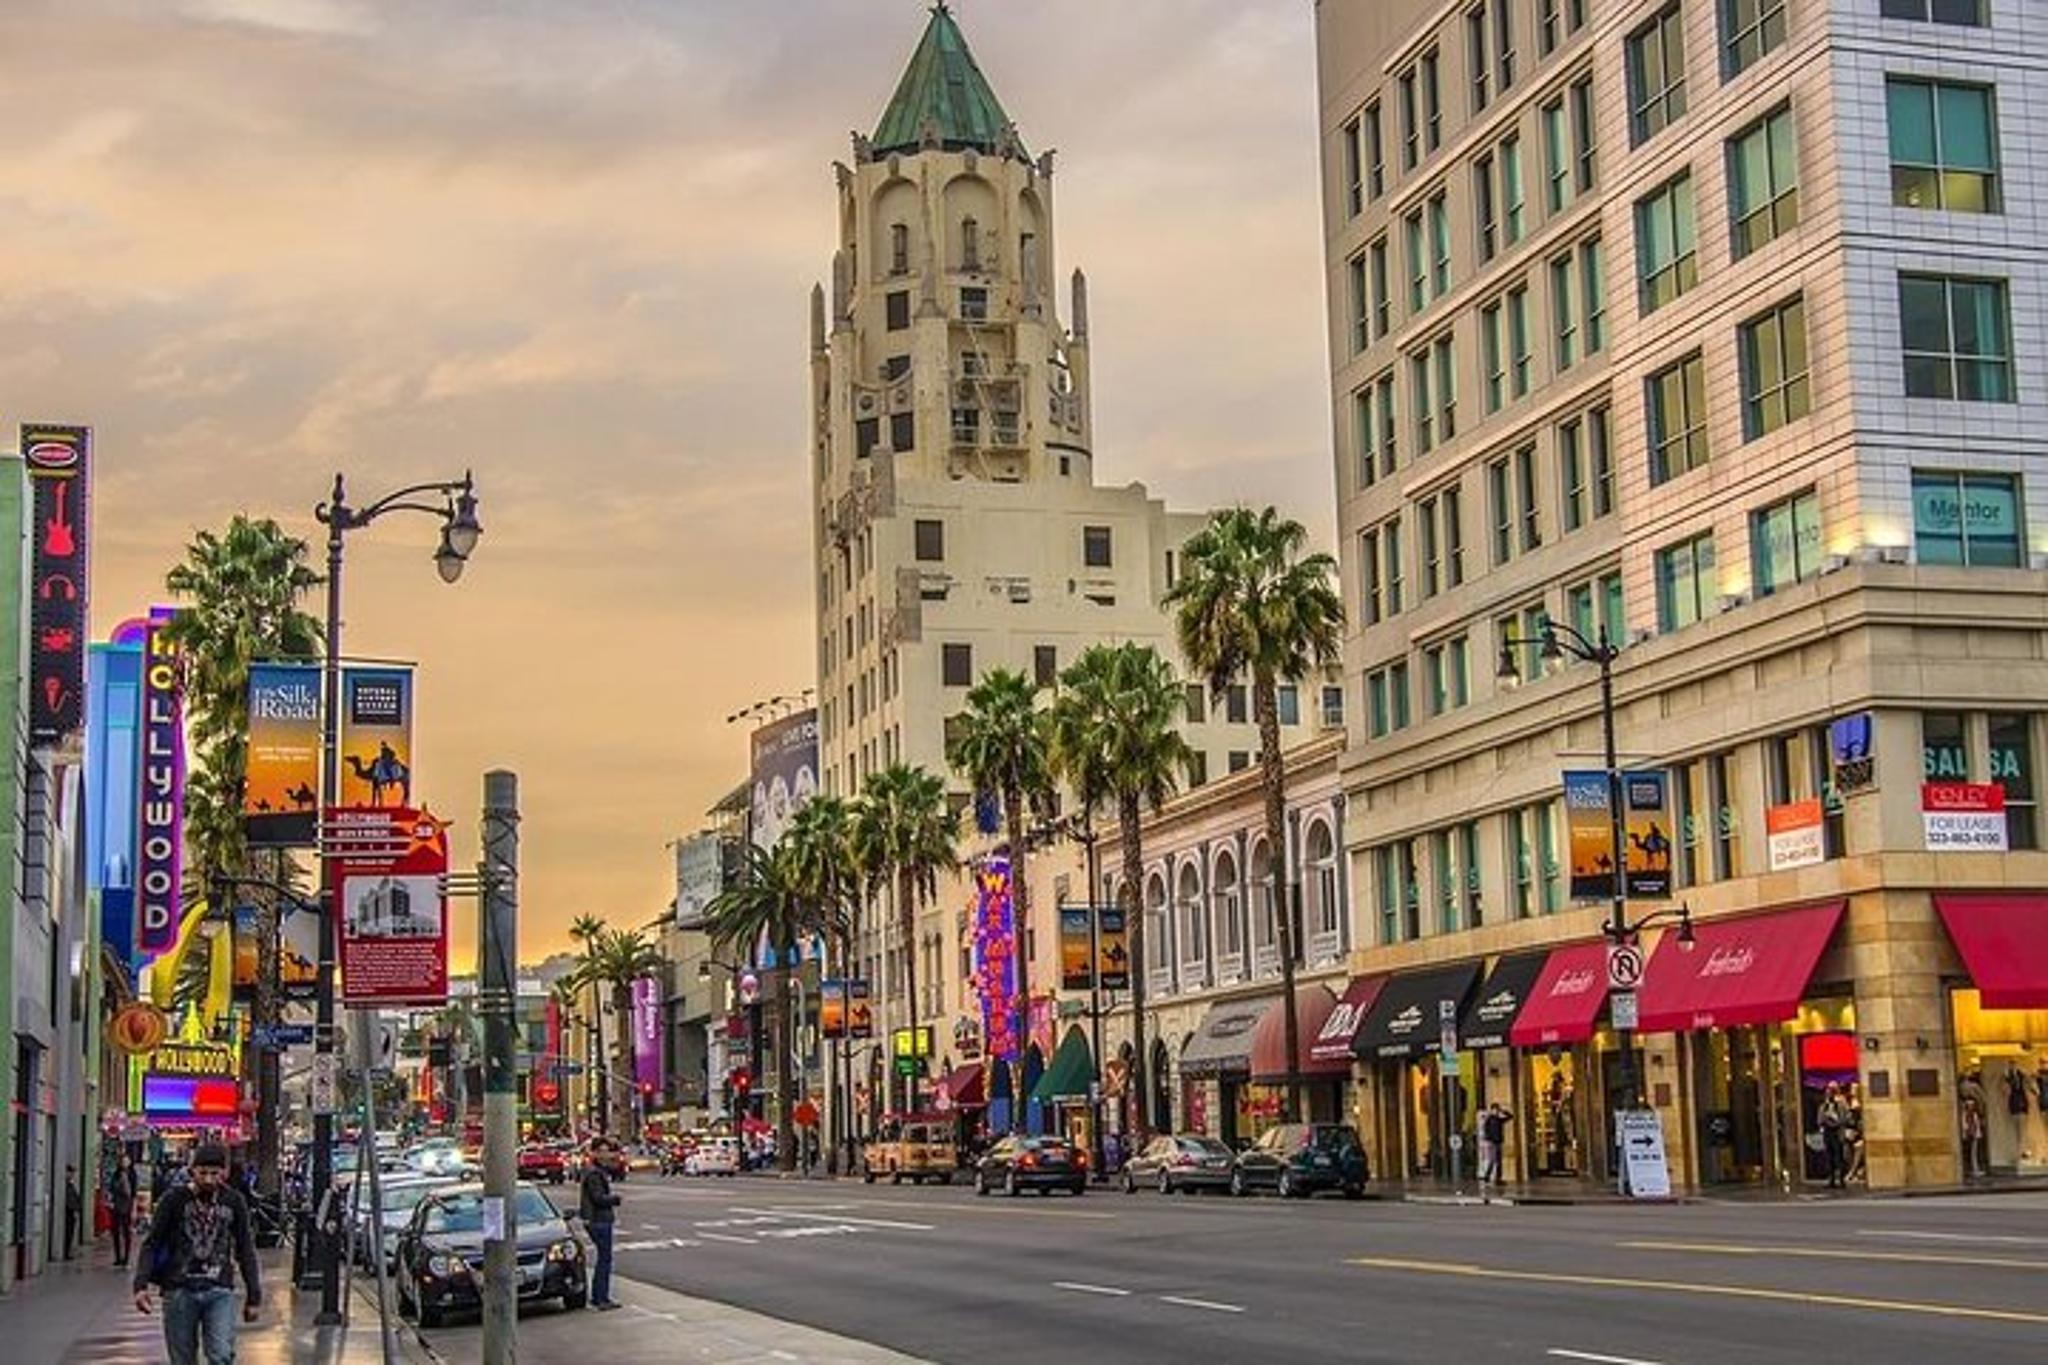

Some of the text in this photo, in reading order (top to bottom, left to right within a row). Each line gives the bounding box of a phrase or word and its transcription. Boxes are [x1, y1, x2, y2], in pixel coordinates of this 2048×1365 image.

[277, 684, 311, 704] Silk
[261, 699, 317, 719] Road
[145, 631, 175, 928] HOLLYWOOD
[1930, 818, 1953, 831] FOR
